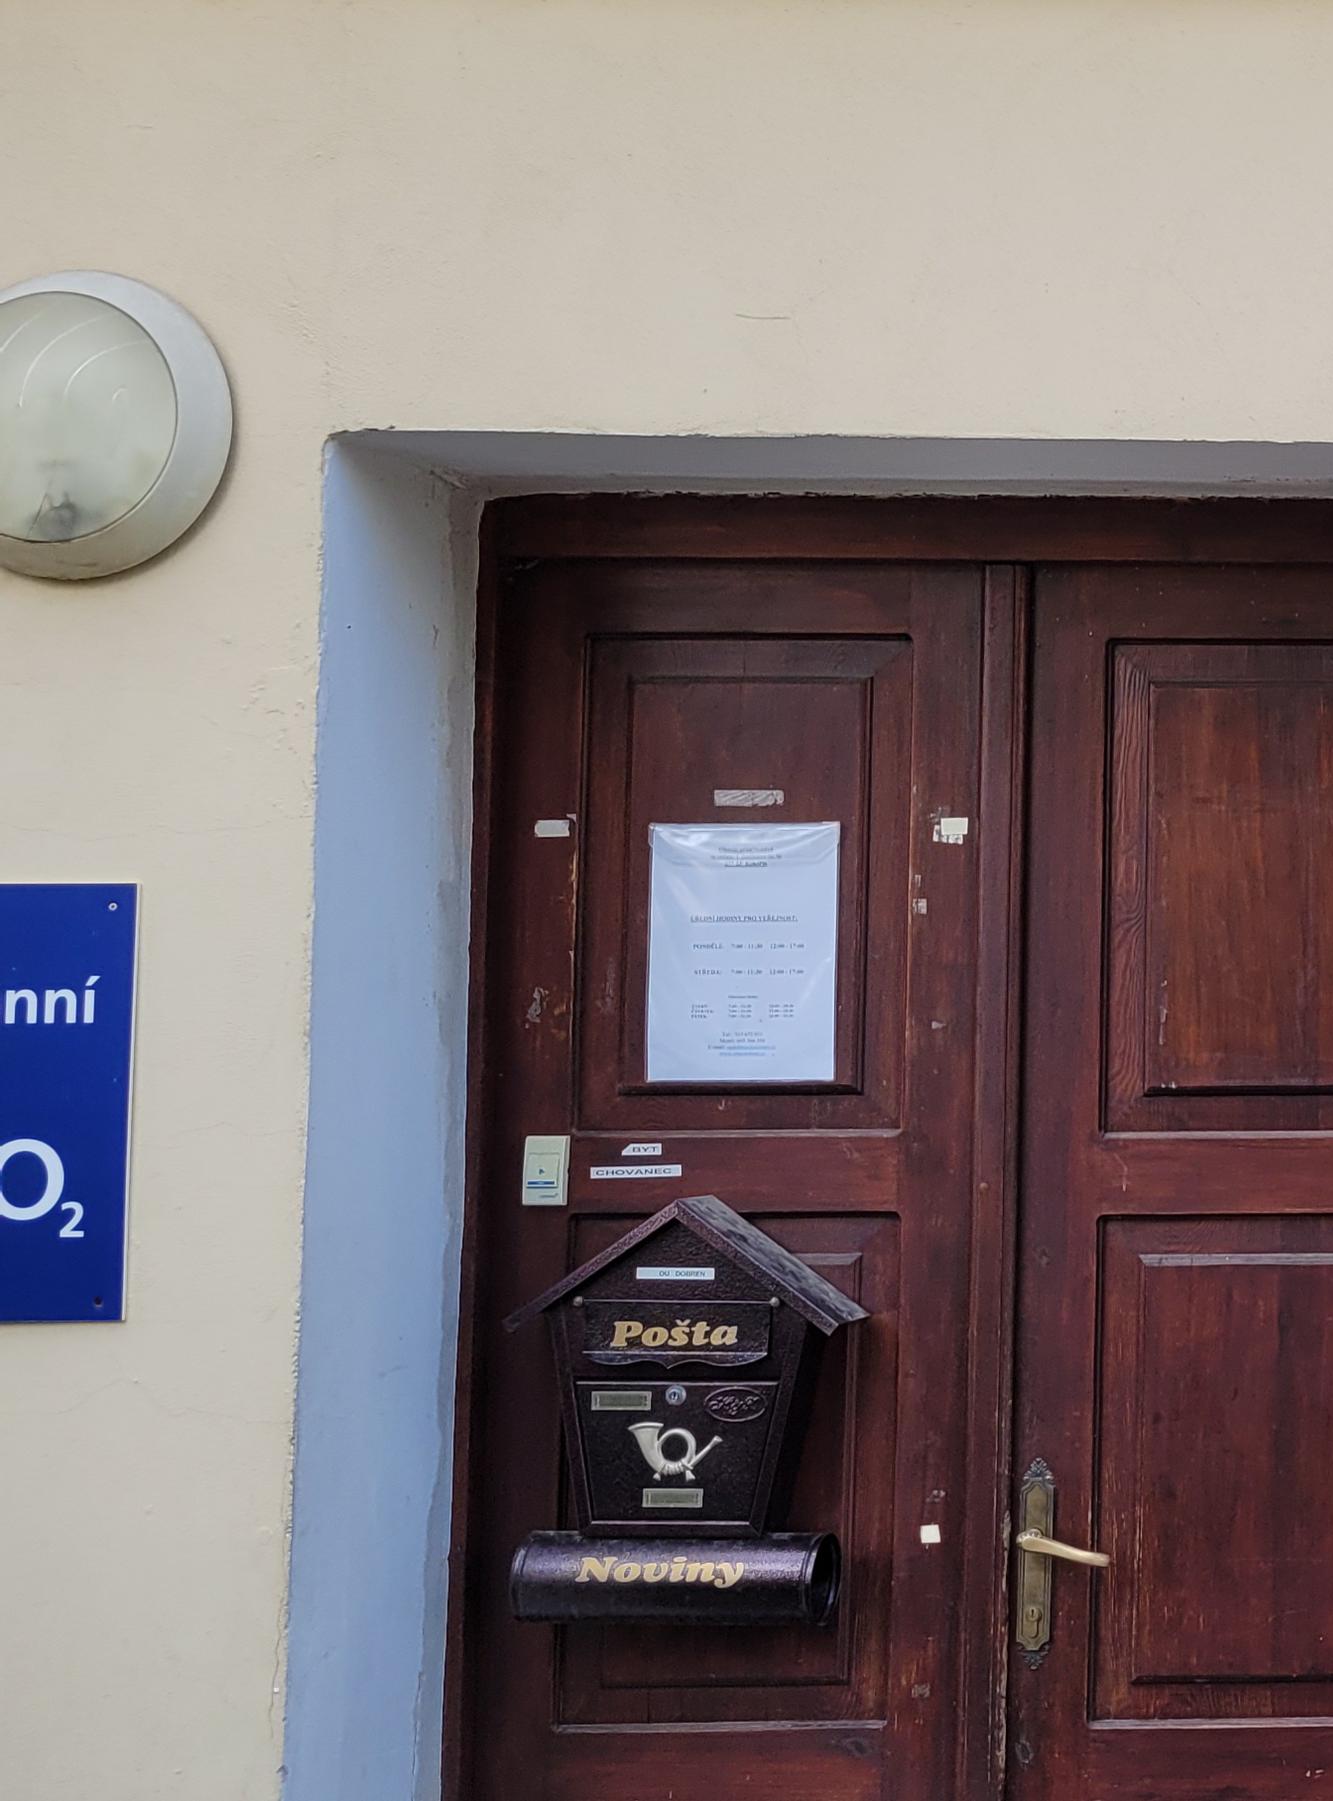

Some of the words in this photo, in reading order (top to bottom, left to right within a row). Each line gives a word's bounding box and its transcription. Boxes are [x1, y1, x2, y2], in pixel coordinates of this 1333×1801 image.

[596, 1167, 672, 1177] CHOVANEC
[610, 1319, 739, 1348] Pošta
[575, 1555, 746, 1588] Noviny
